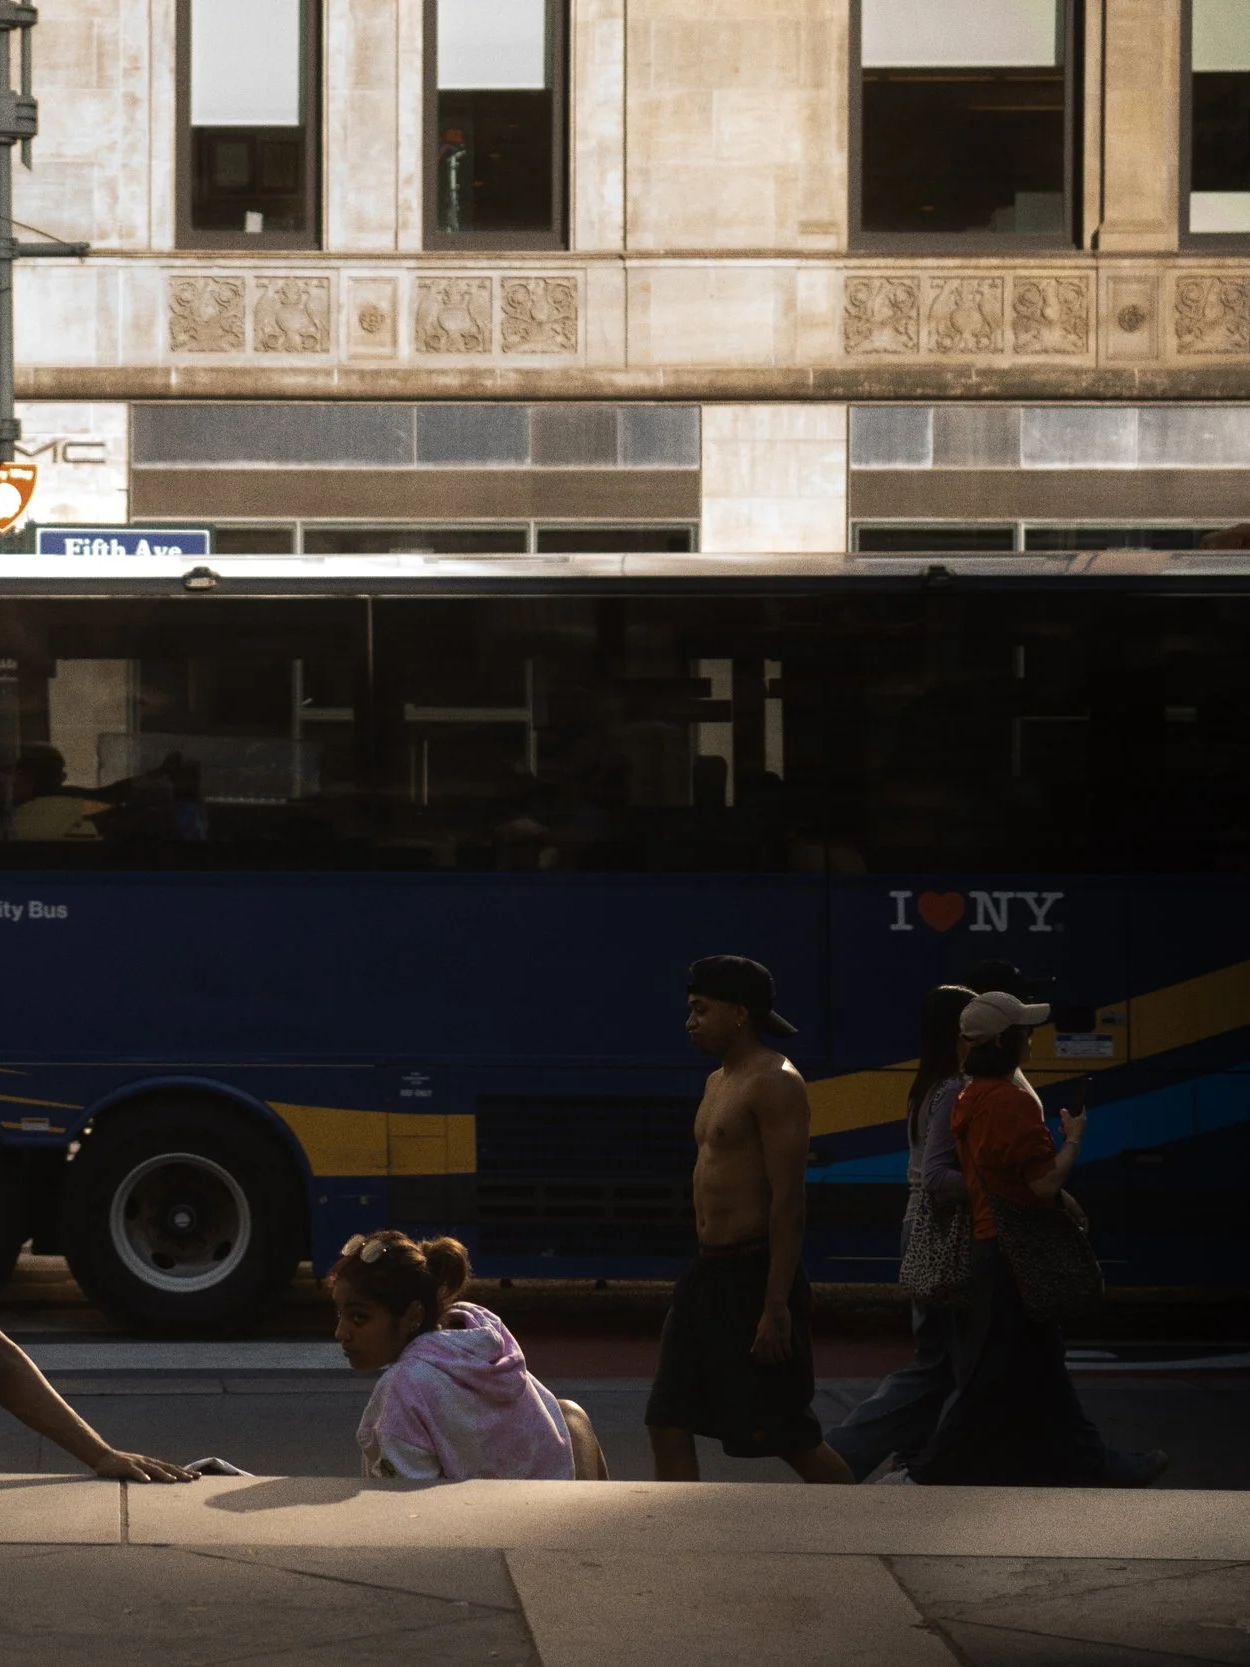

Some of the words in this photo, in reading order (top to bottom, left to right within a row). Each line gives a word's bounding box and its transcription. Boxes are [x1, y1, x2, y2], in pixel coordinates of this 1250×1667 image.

[65, 538, 126, 555] Fifth
[135, 539, 182, 555] Ave
[28, 899, 69, 919] Bus
[889, 890, 914, 931] I
[968, 891, 1065, 932] NY
